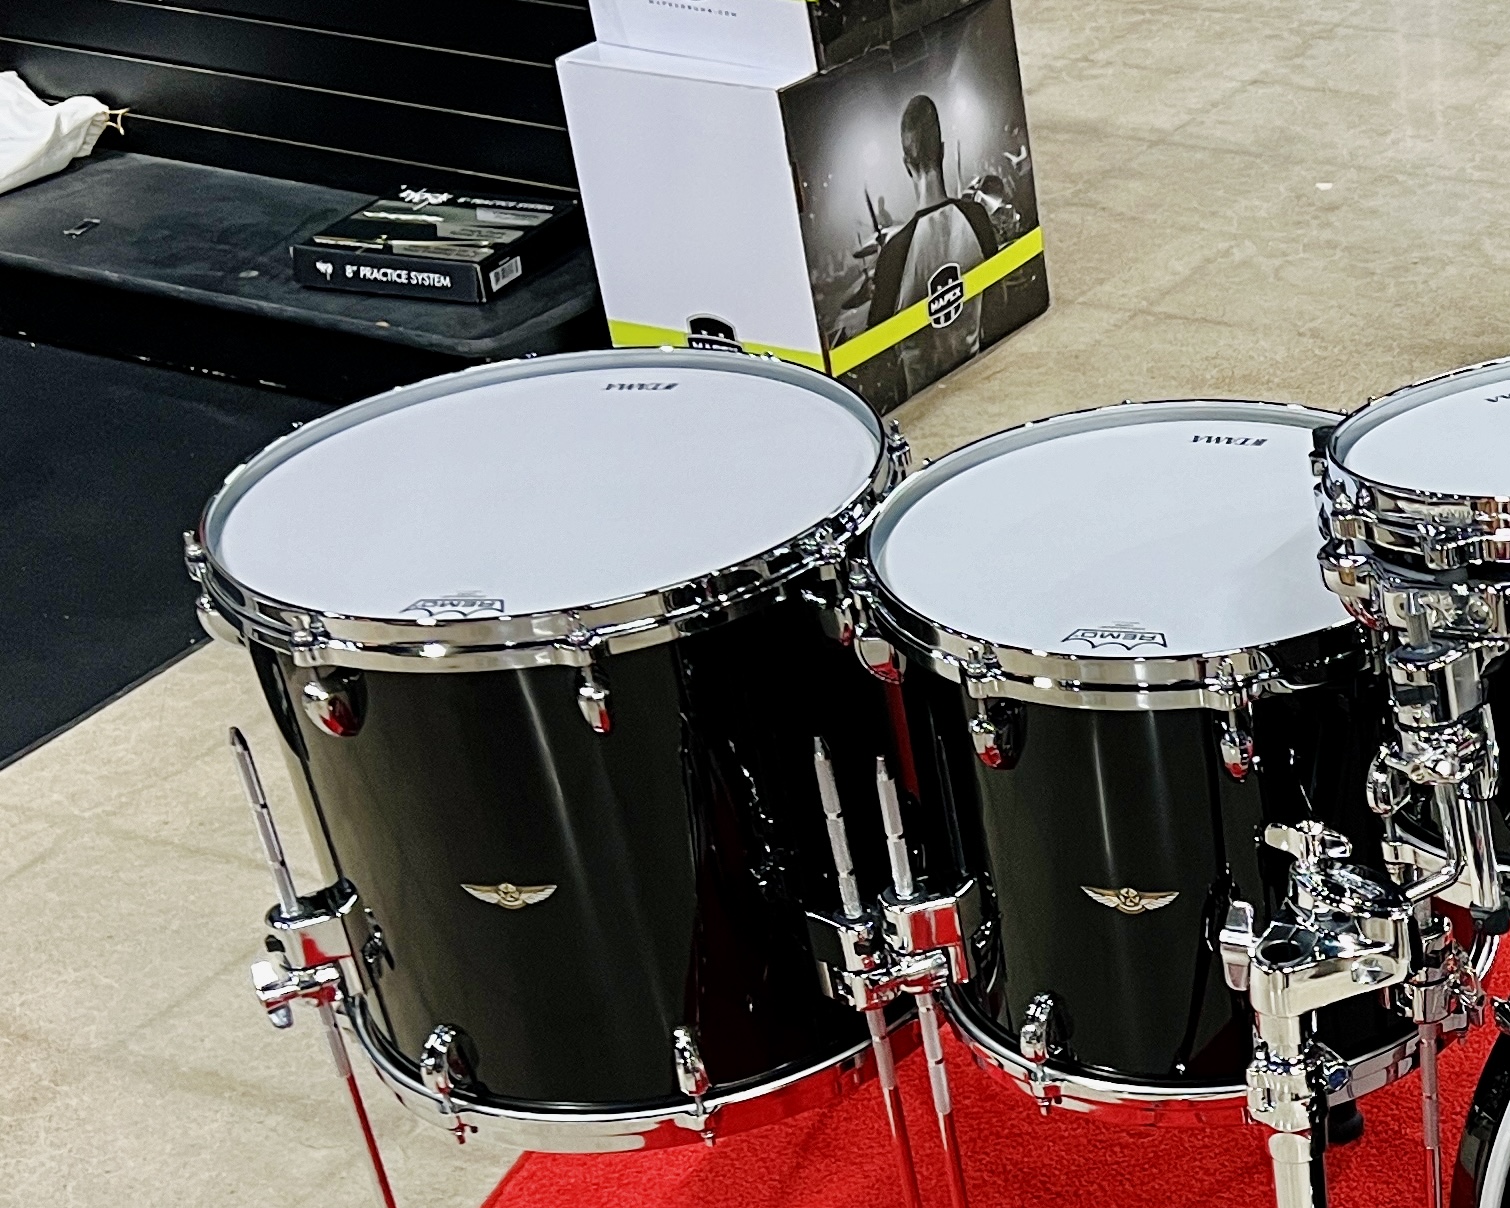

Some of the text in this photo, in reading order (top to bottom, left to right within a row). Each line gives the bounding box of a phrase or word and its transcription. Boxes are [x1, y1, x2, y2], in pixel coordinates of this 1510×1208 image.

[359, 266, 408, 284] PRACTICE
[410, 271, 452, 288] SYSTEM
[930, 286, 962, 313] MAPEX
[1189, 435, 1251, 446] TAMA
[421, 600, 496, 608] REMO
[1080, 631, 1157, 642] REMO
